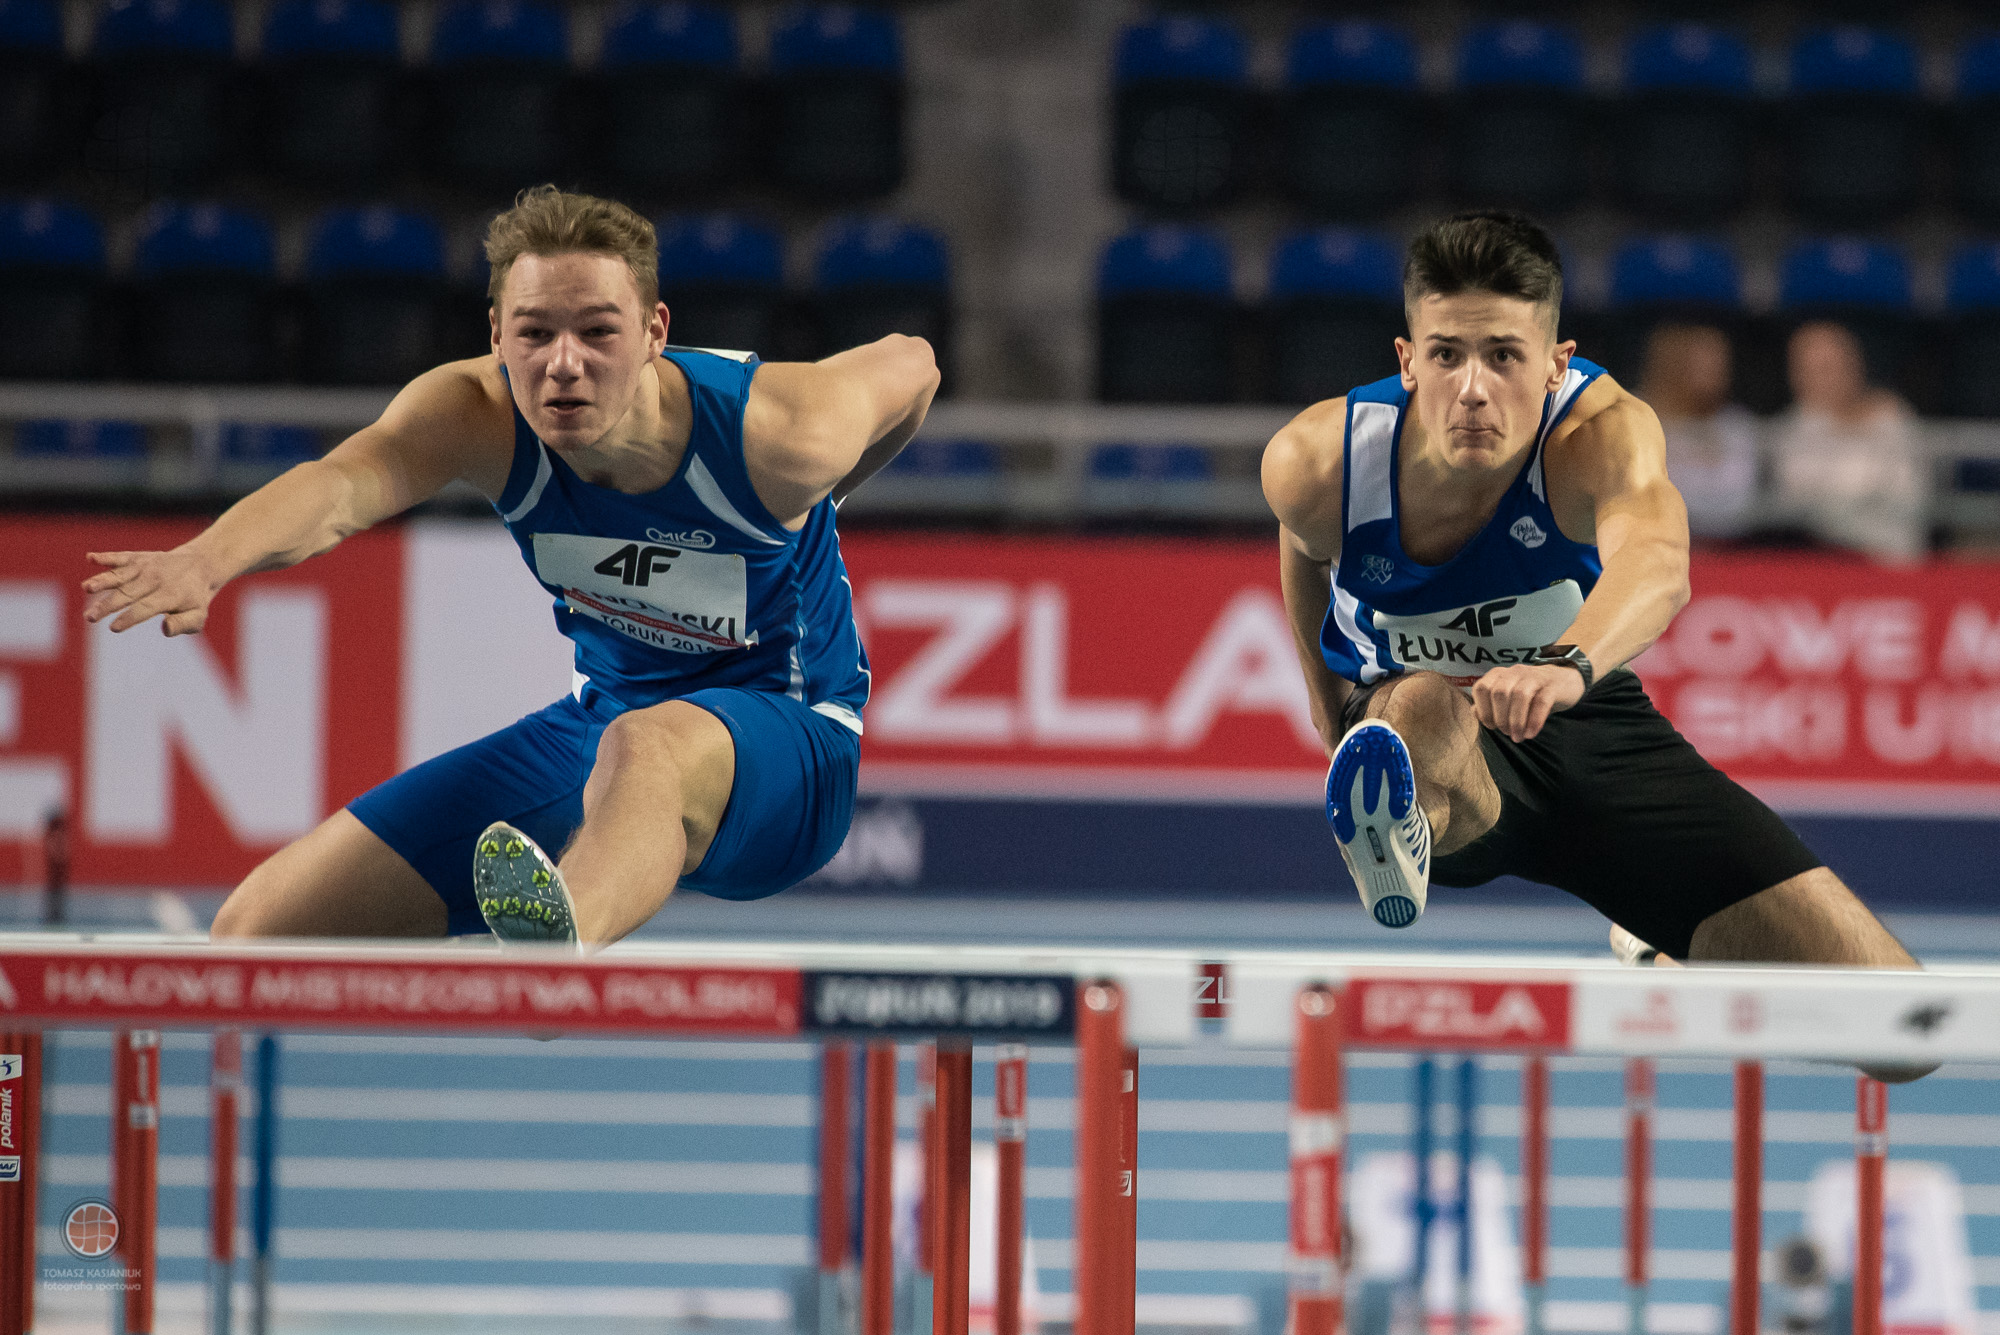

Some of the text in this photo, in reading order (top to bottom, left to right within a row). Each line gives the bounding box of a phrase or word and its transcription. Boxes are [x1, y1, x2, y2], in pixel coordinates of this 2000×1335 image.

[594, 543, 681, 587] 4F
[601, 614, 665, 645] TORUŃ
[1439, 597, 1517, 637] 4F
[855, 578, 1318, 751] ZLA
[1, 1087, 14, 1149] polanik
